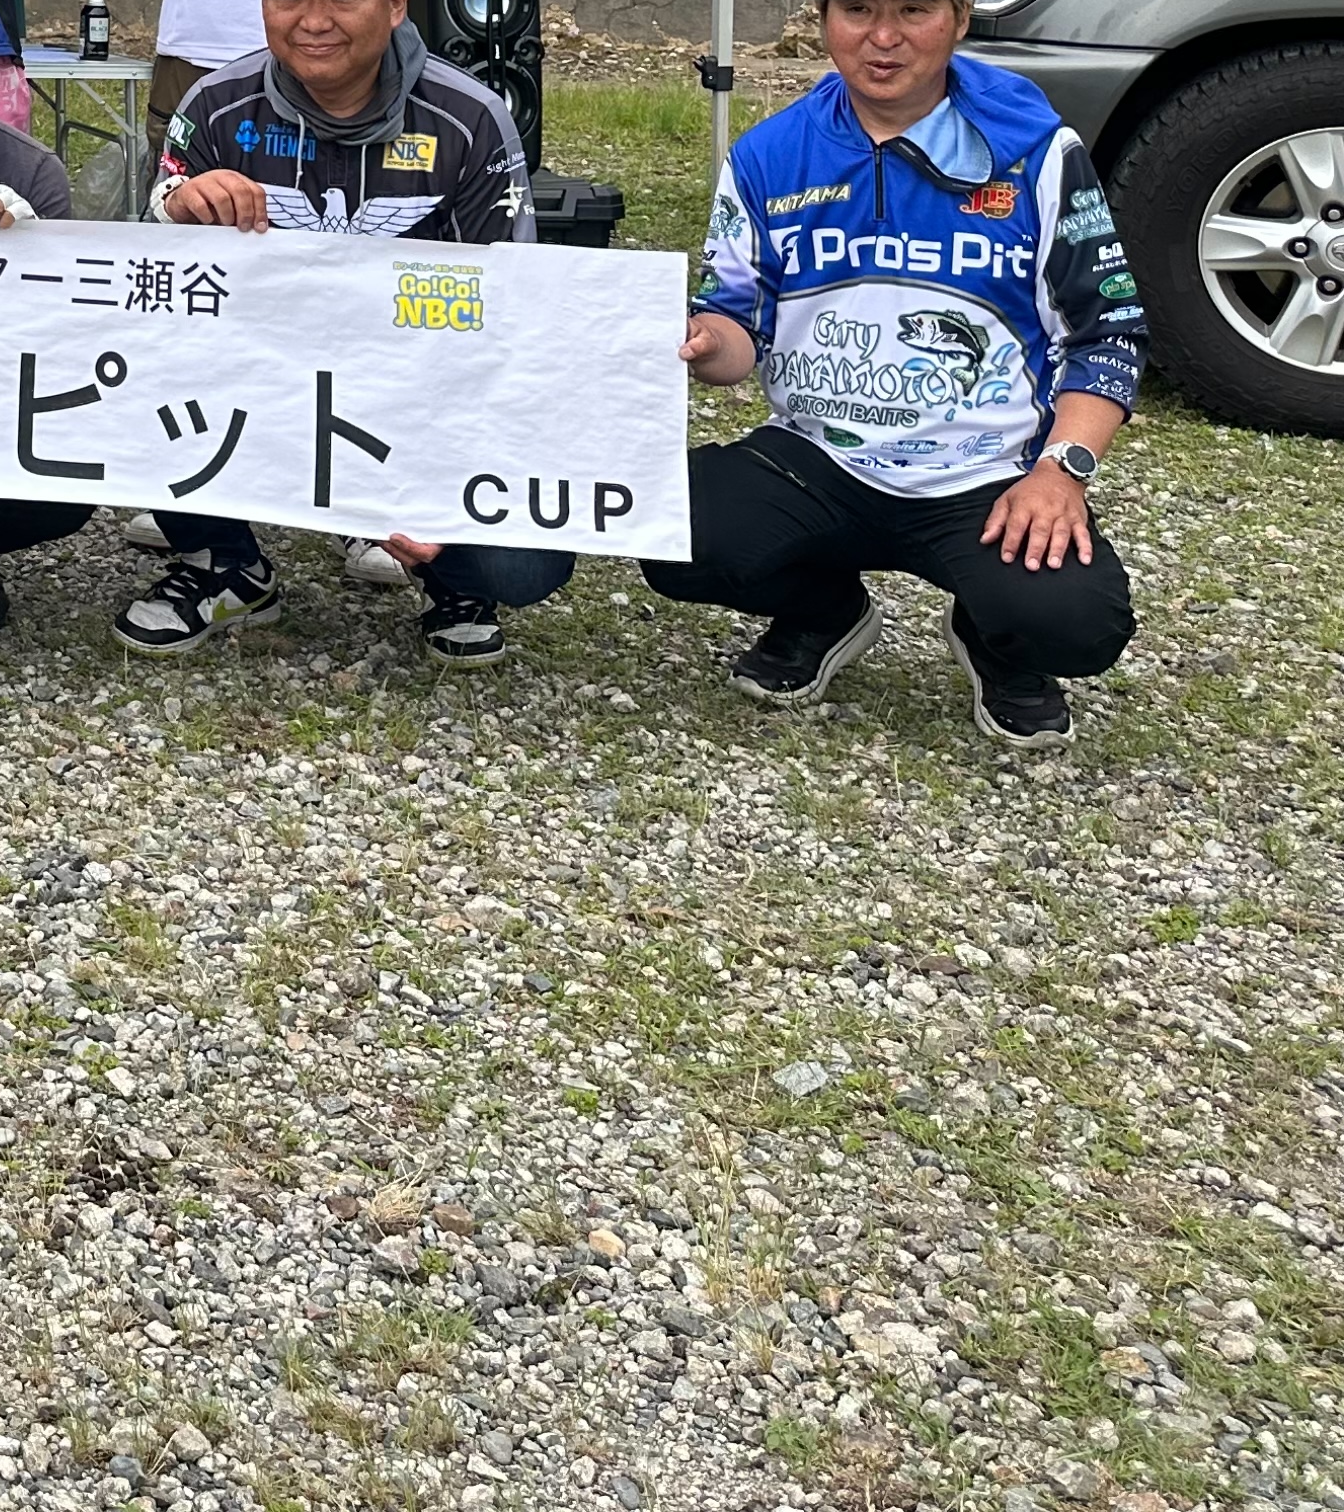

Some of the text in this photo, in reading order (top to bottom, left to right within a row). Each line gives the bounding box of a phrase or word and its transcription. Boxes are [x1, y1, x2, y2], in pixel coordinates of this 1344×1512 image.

[388, 141, 429, 161] NBC
[812, 228, 942, 273] Pro's
[952, 232, 1033, 278] Pit
[399, 274, 479, 298] Go!Go!
[393, 294, 484, 331] NBC!
[769, 351, 957, 404] YAMAMOTO
[850, 404, 920, 427] BAITS
[463, 473, 634, 533] CUP
